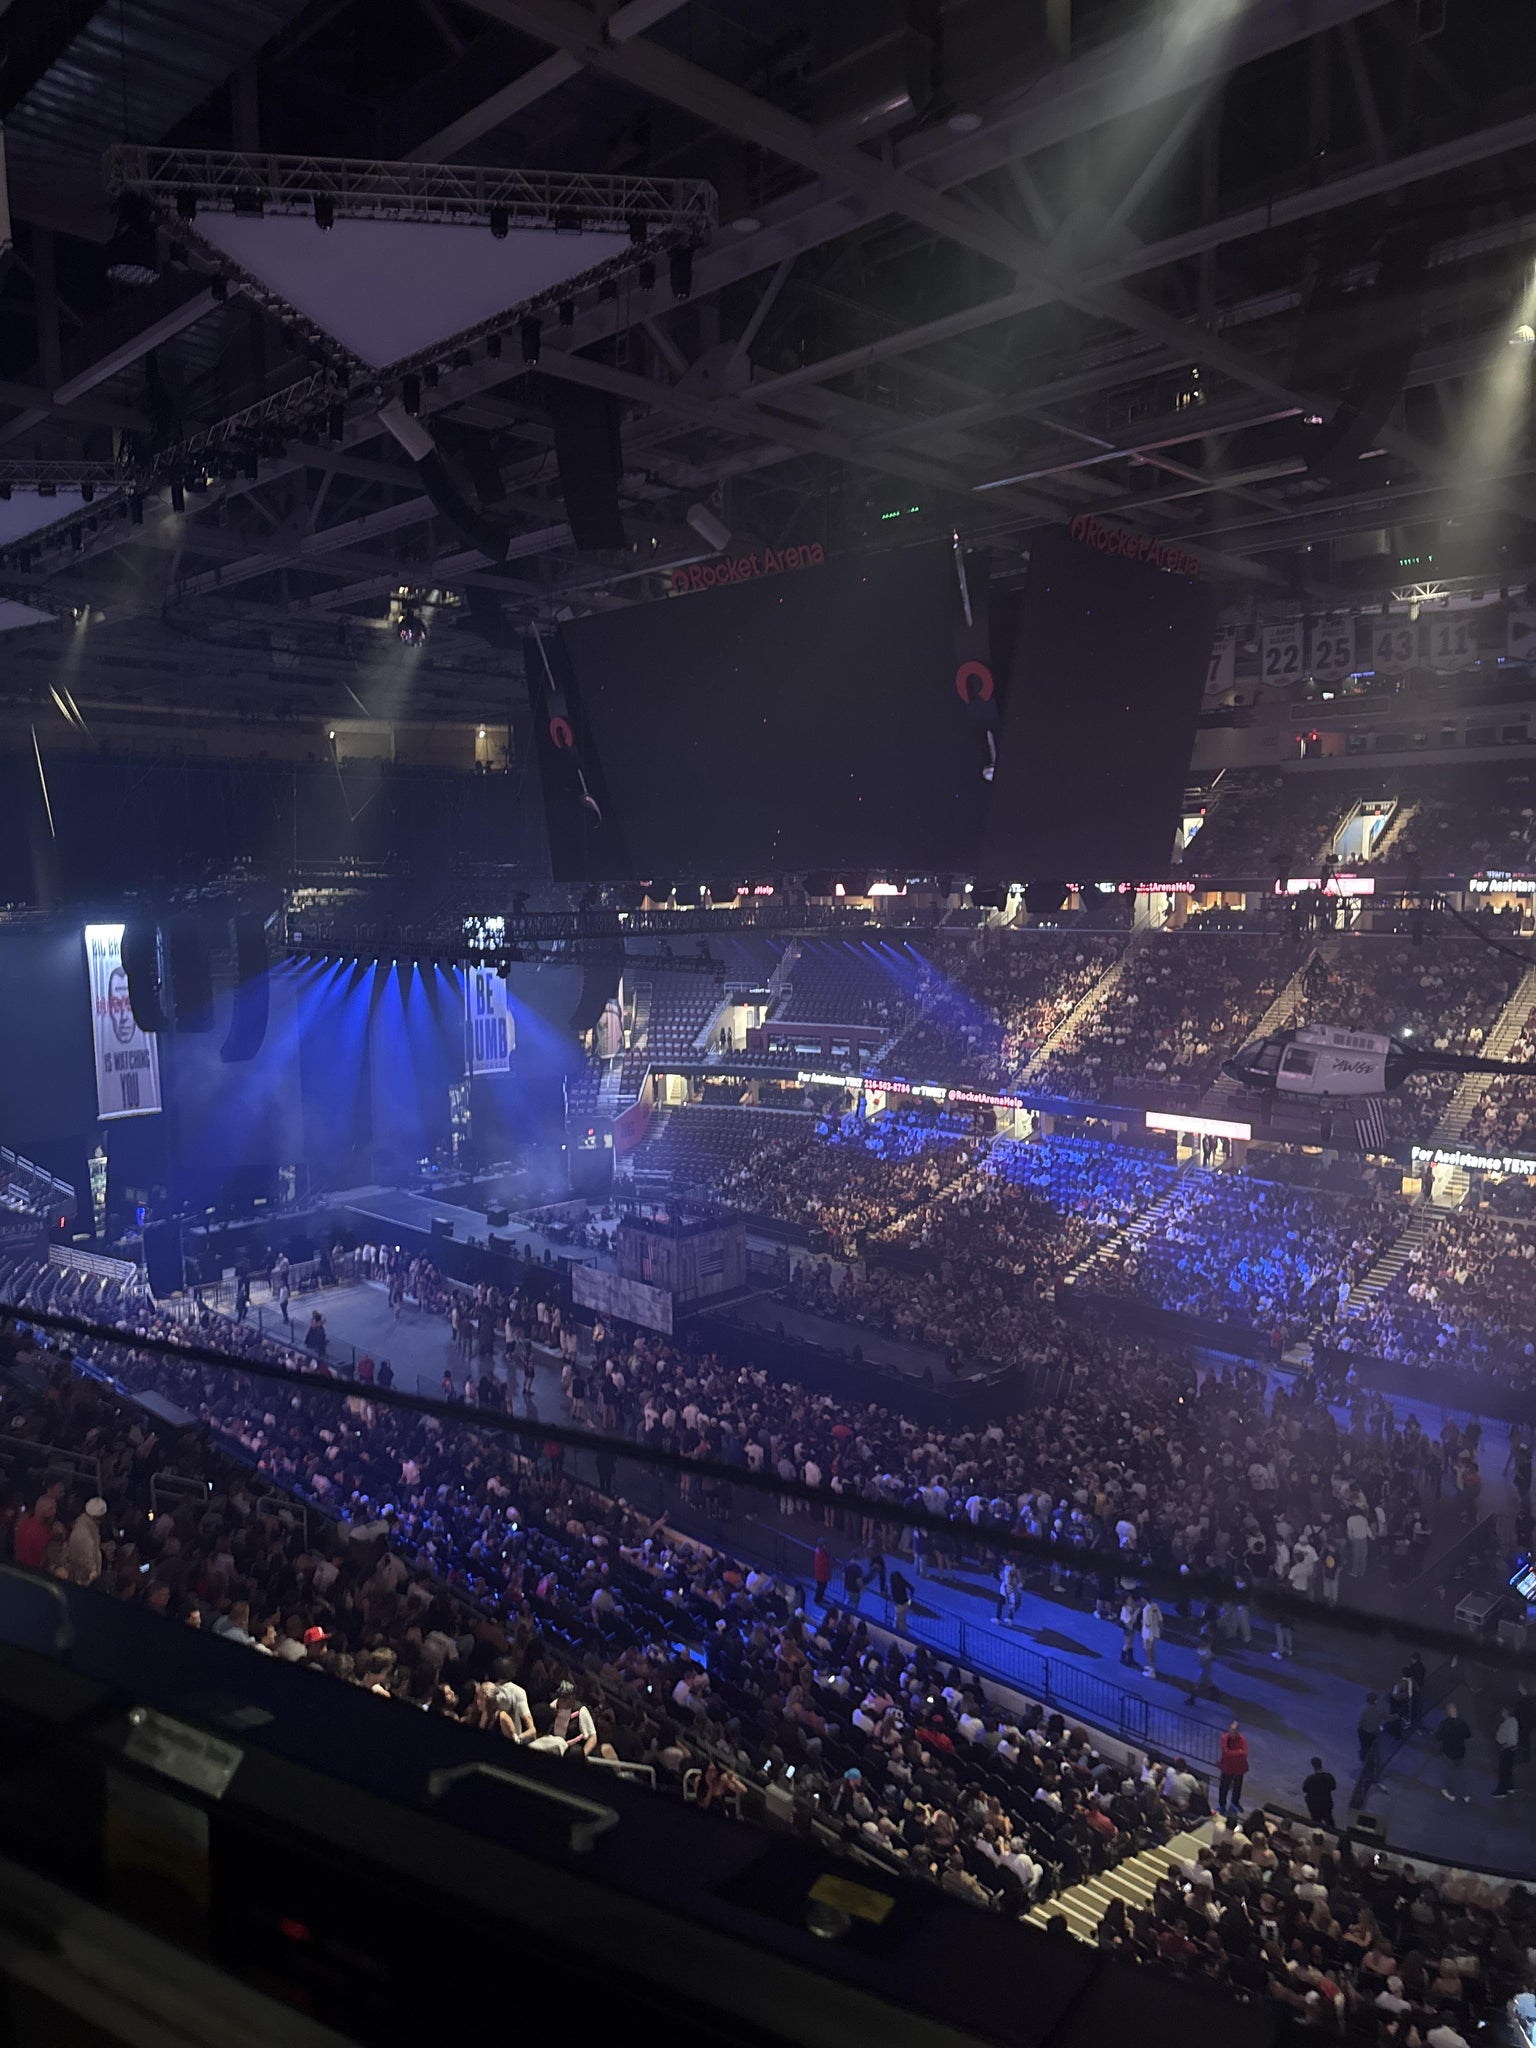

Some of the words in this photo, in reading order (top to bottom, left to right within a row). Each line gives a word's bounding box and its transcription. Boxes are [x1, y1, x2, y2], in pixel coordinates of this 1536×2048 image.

[1085, 515, 1147, 561] Rocket
[1147, 536, 1200, 576] Arena
[688, 553, 763, 589] Rocket
[764, 542, 825, 573] Arena
[1316, 637, 1351, 669] 25
[1377, 630, 1414, 662] 43
[1437, 625, 1469, 656] 11
[1265, 644, 1299, 676] 22
[1469, 878, 1489, 893] For
[476, 972, 495, 1015] BE
[104, 1052, 113, 1073] IS
[114, 1048, 151, 1072] WATCHING
[1333, 1059, 1377, 1074] AWGE
[120, 1072, 140, 1109] YOU
[797, 1071, 812, 1082] For
[948, 1089, 1024, 1109] @RocketArenaHelp
[1411, 1145, 1434, 1161] For
[1434, 1148, 1502, 1170] Assistance
[1502, 1157, 1536, 1175] TEXT
